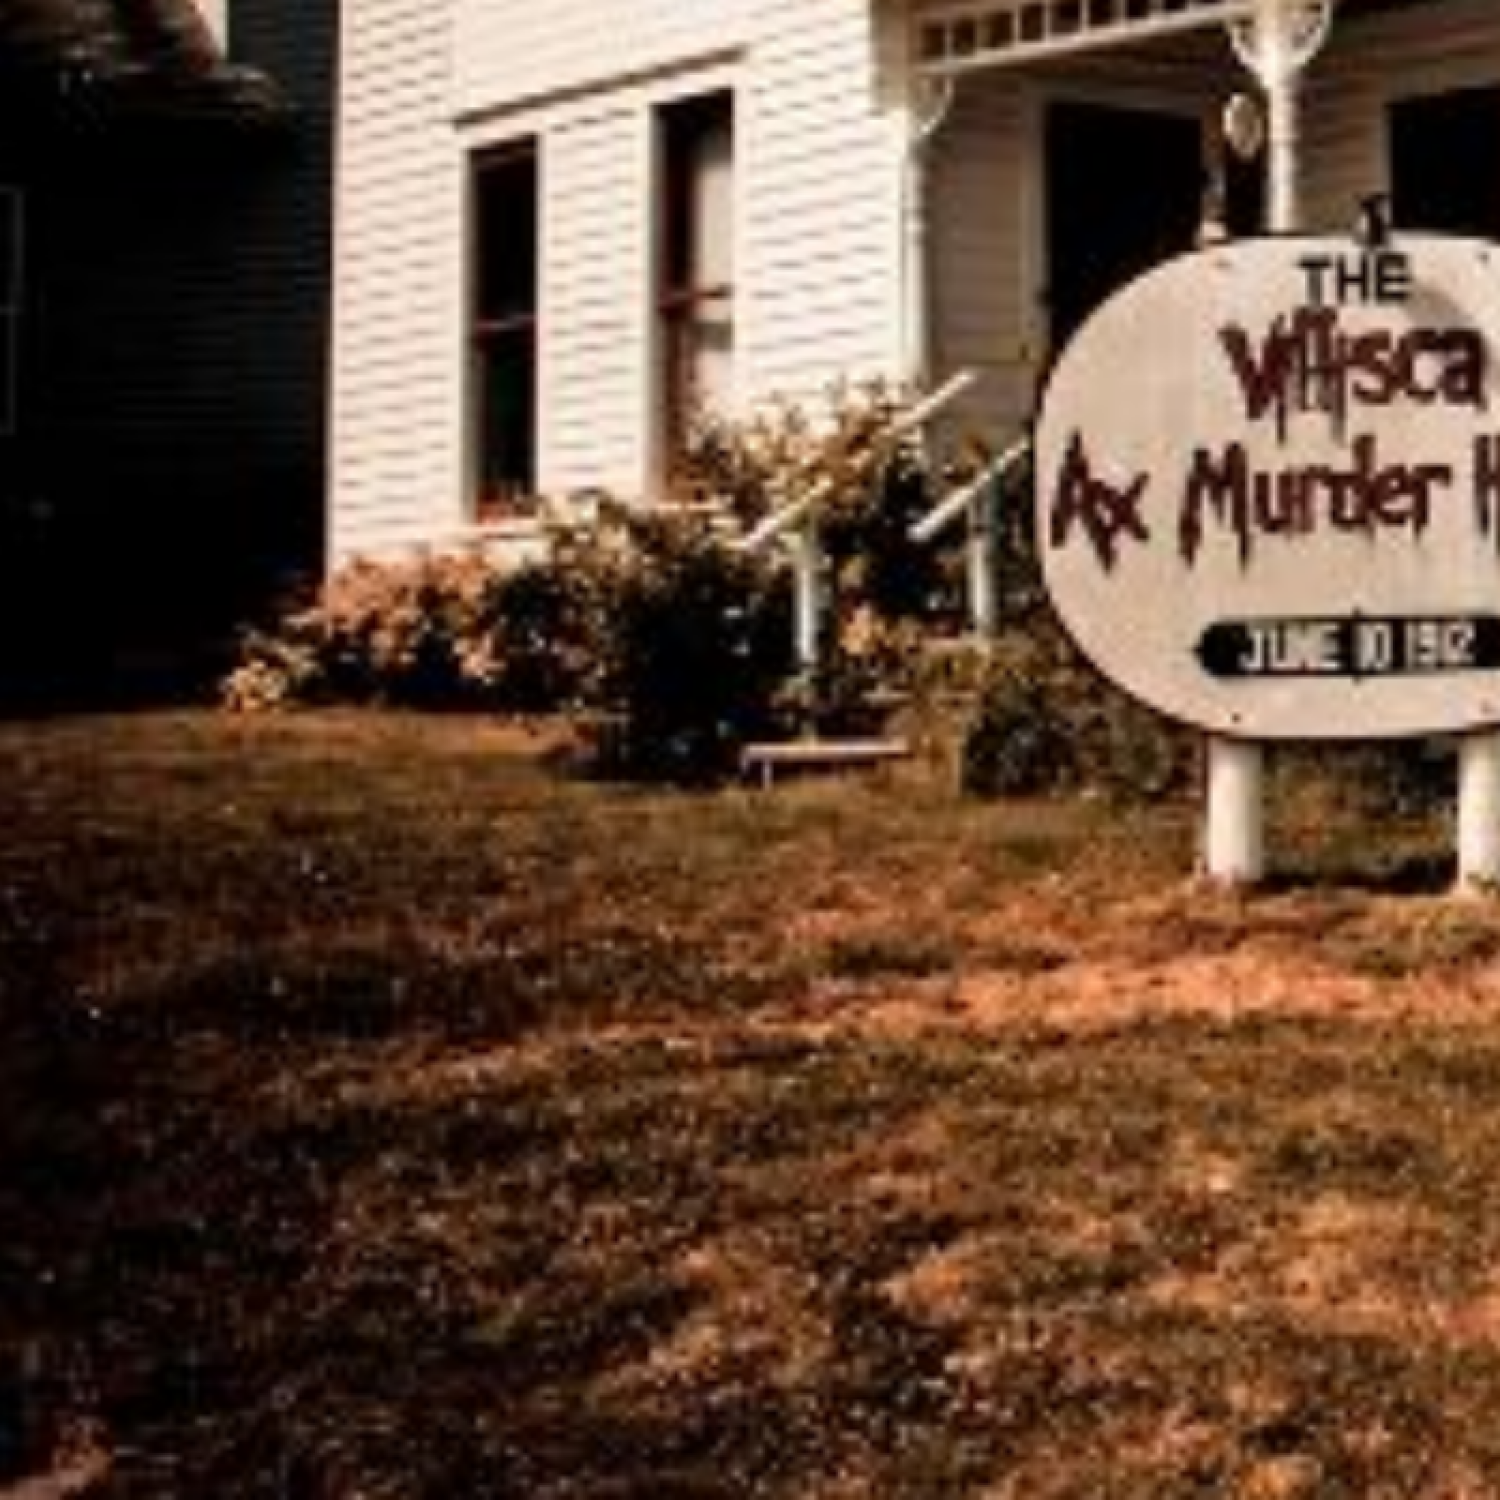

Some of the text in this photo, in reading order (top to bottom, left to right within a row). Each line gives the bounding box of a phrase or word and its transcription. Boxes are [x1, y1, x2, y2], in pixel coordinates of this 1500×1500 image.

[1298, 252, 1410, 305] THE
[1050, 430, 1149, 572] Ax
[1178, 433, 1452, 573] Murder
